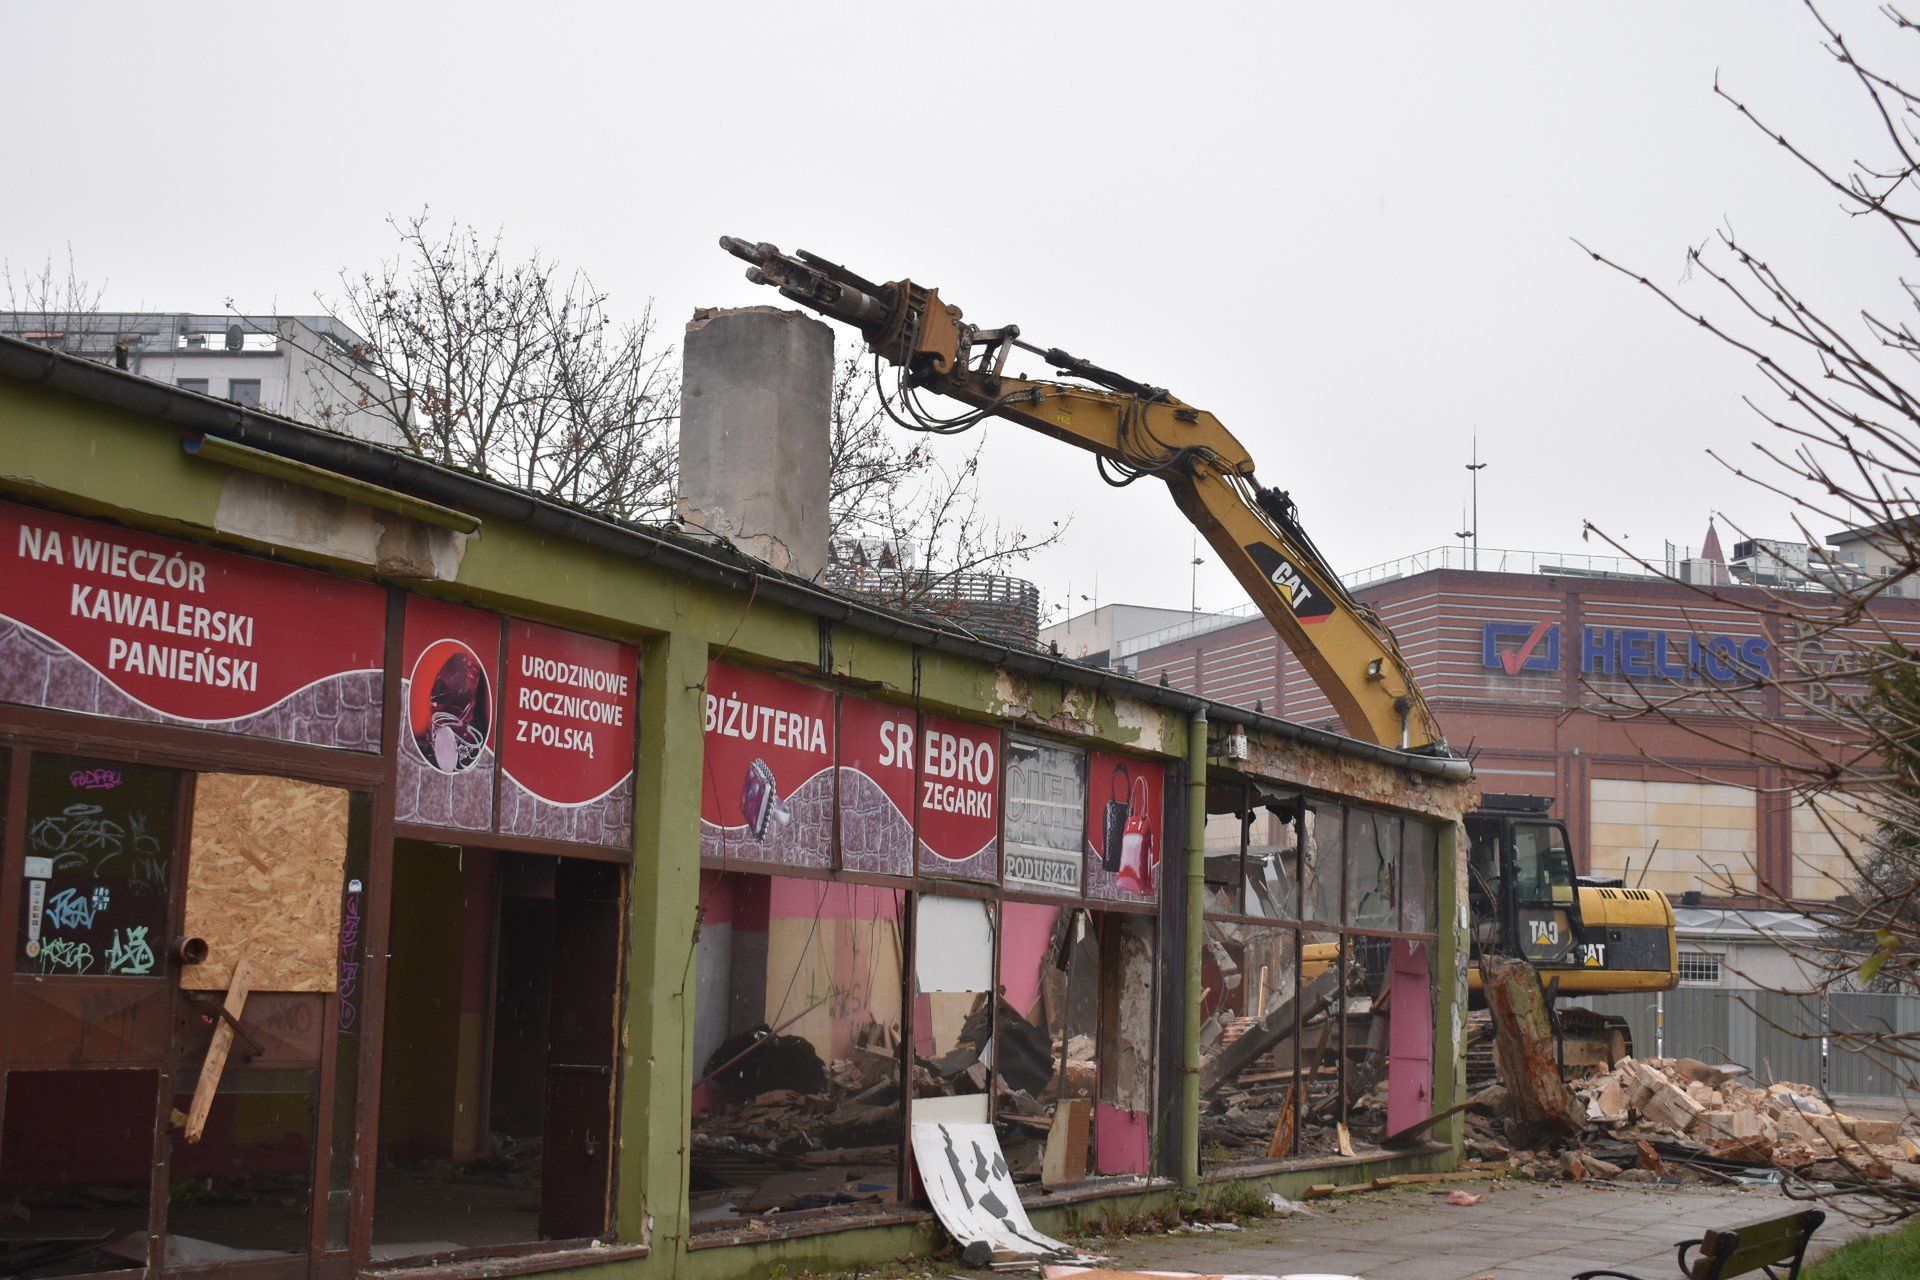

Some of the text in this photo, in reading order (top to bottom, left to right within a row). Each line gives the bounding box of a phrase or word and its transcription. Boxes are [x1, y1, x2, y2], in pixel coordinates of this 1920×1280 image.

[18, 524, 206, 594] NA WIECZÓR
[1271, 561, 1313, 610] CAT
[70, 583, 254, 647] KAWALERSKI
[108, 637, 258, 692] PANIEŃSKI
[521, 654, 628, 697] URODZINOWE
[1581, 626, 1771, 681] HELIOS
[519, 687, 623, 727] ROCZNICOWE
[704, 691, 827, 755] BIŻUTERIA
[516, 719, 594, 759] Z POLSKĄ
[922, 781, 992, 819] ZEGARKI
[1006, 855, 1077, 885] PODUSZKI
